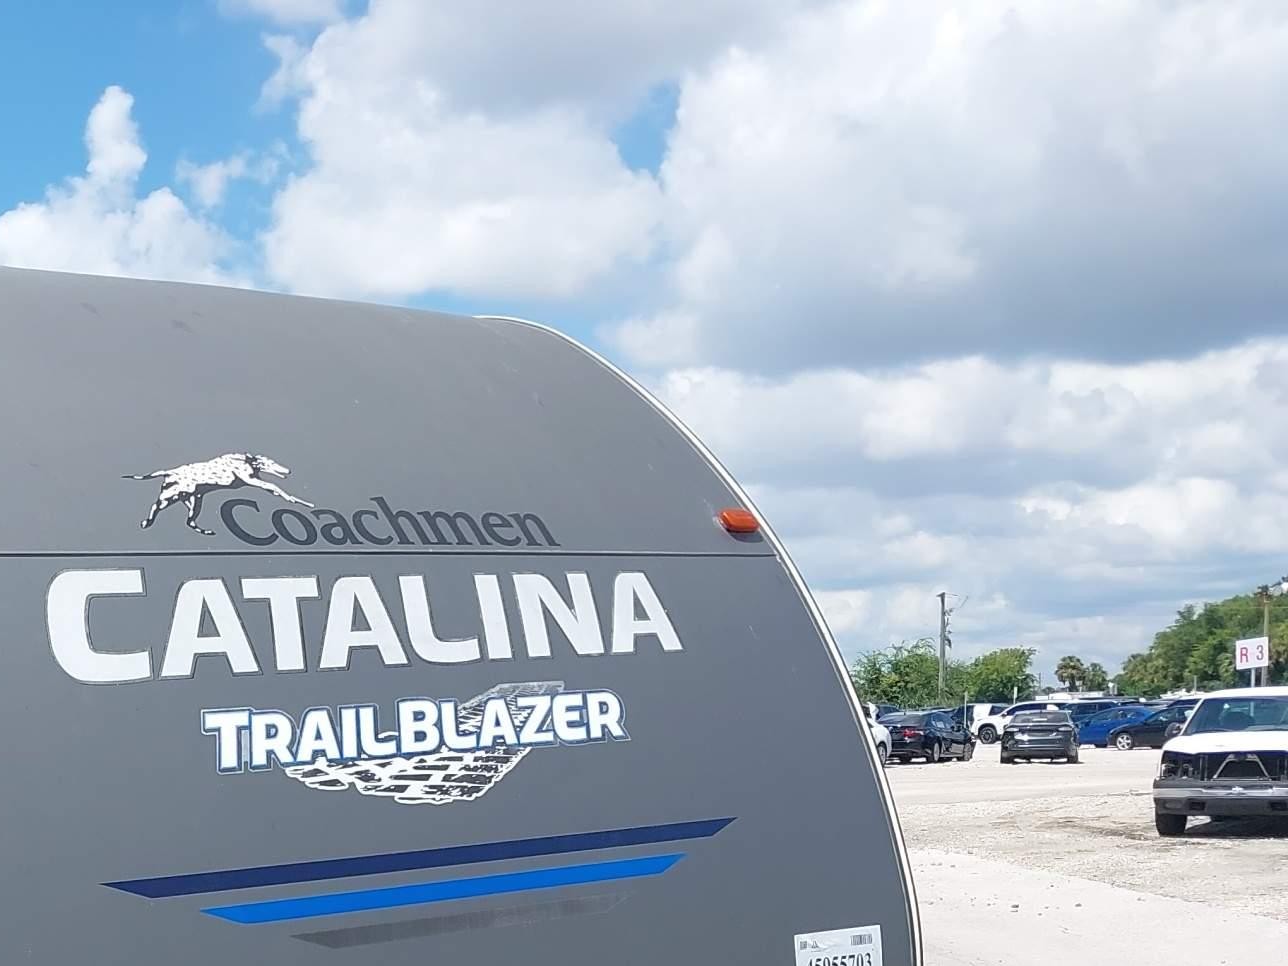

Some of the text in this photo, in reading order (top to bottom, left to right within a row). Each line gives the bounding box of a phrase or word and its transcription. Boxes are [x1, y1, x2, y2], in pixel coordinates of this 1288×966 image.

[220, 496, 562, 547] Coachmen
[46, 567, 684, 686] CATALINA
[1239, 644, 1264, 663] R 3
[200, 688, 631, 775] TRAILBLAZER
